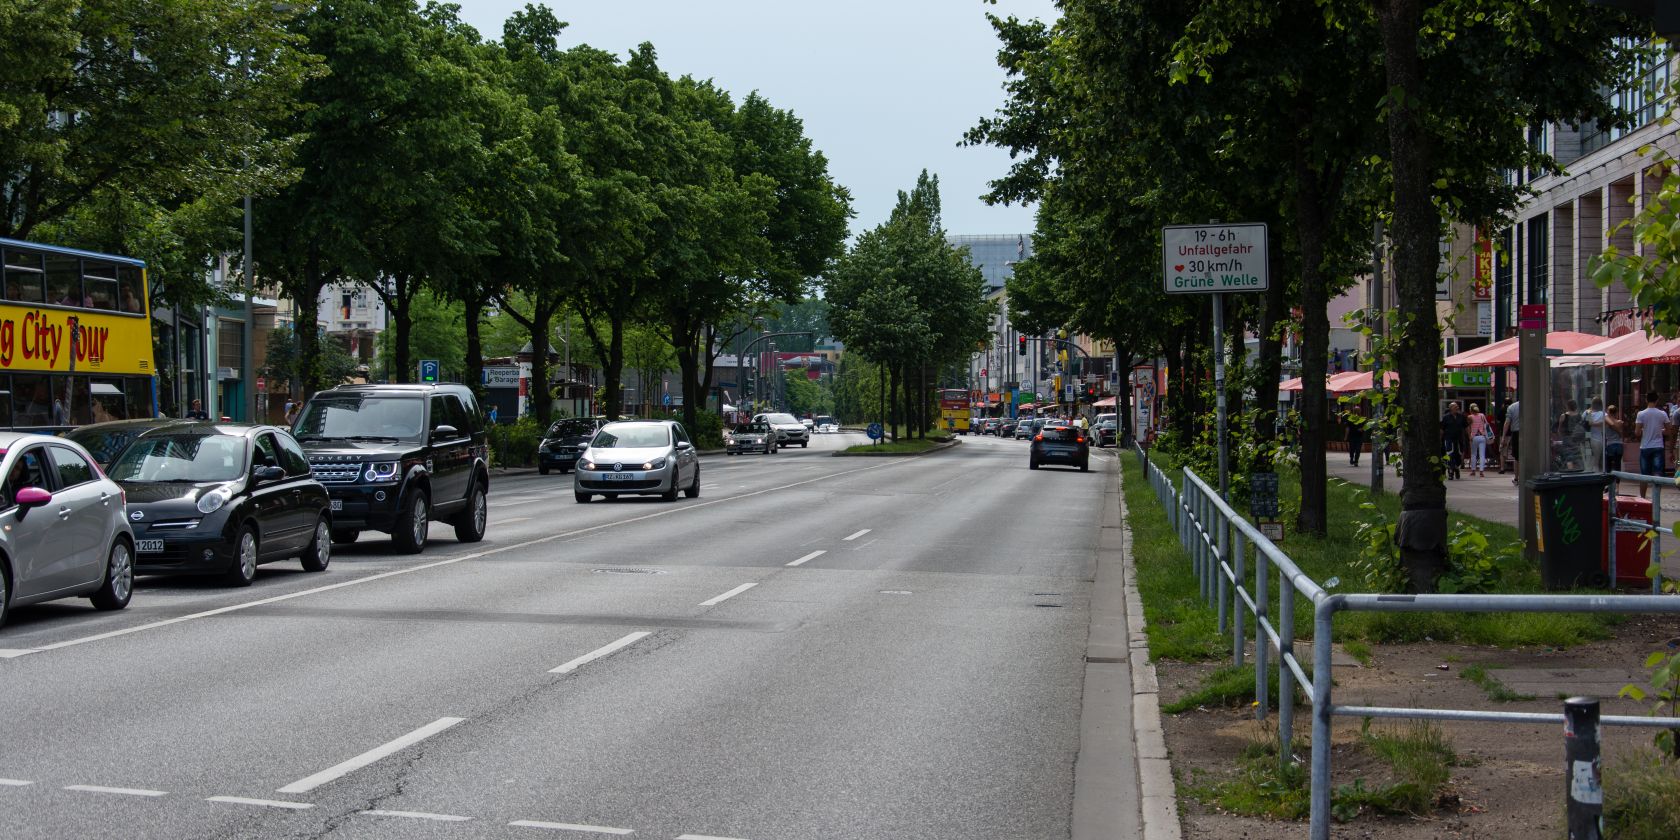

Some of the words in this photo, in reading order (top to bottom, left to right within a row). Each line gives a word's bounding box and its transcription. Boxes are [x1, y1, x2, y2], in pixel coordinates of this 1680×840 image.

[1195, 230, 1207, 242] 19
[1178, 243, 1254, 257] Unfallgefahr
[1189, 260, 1205, 272] 30
[1208, 259, 1242, 272] km/h
[1174, 275, 1215, 288] Grüne
[1220, 274, 1258, 286] Welle
[0, 318, 14, 367] g
[22, 310, 62, 369] City
[67, 315, 108, 363] Tour
[142, 541, 163, 550] 2012
